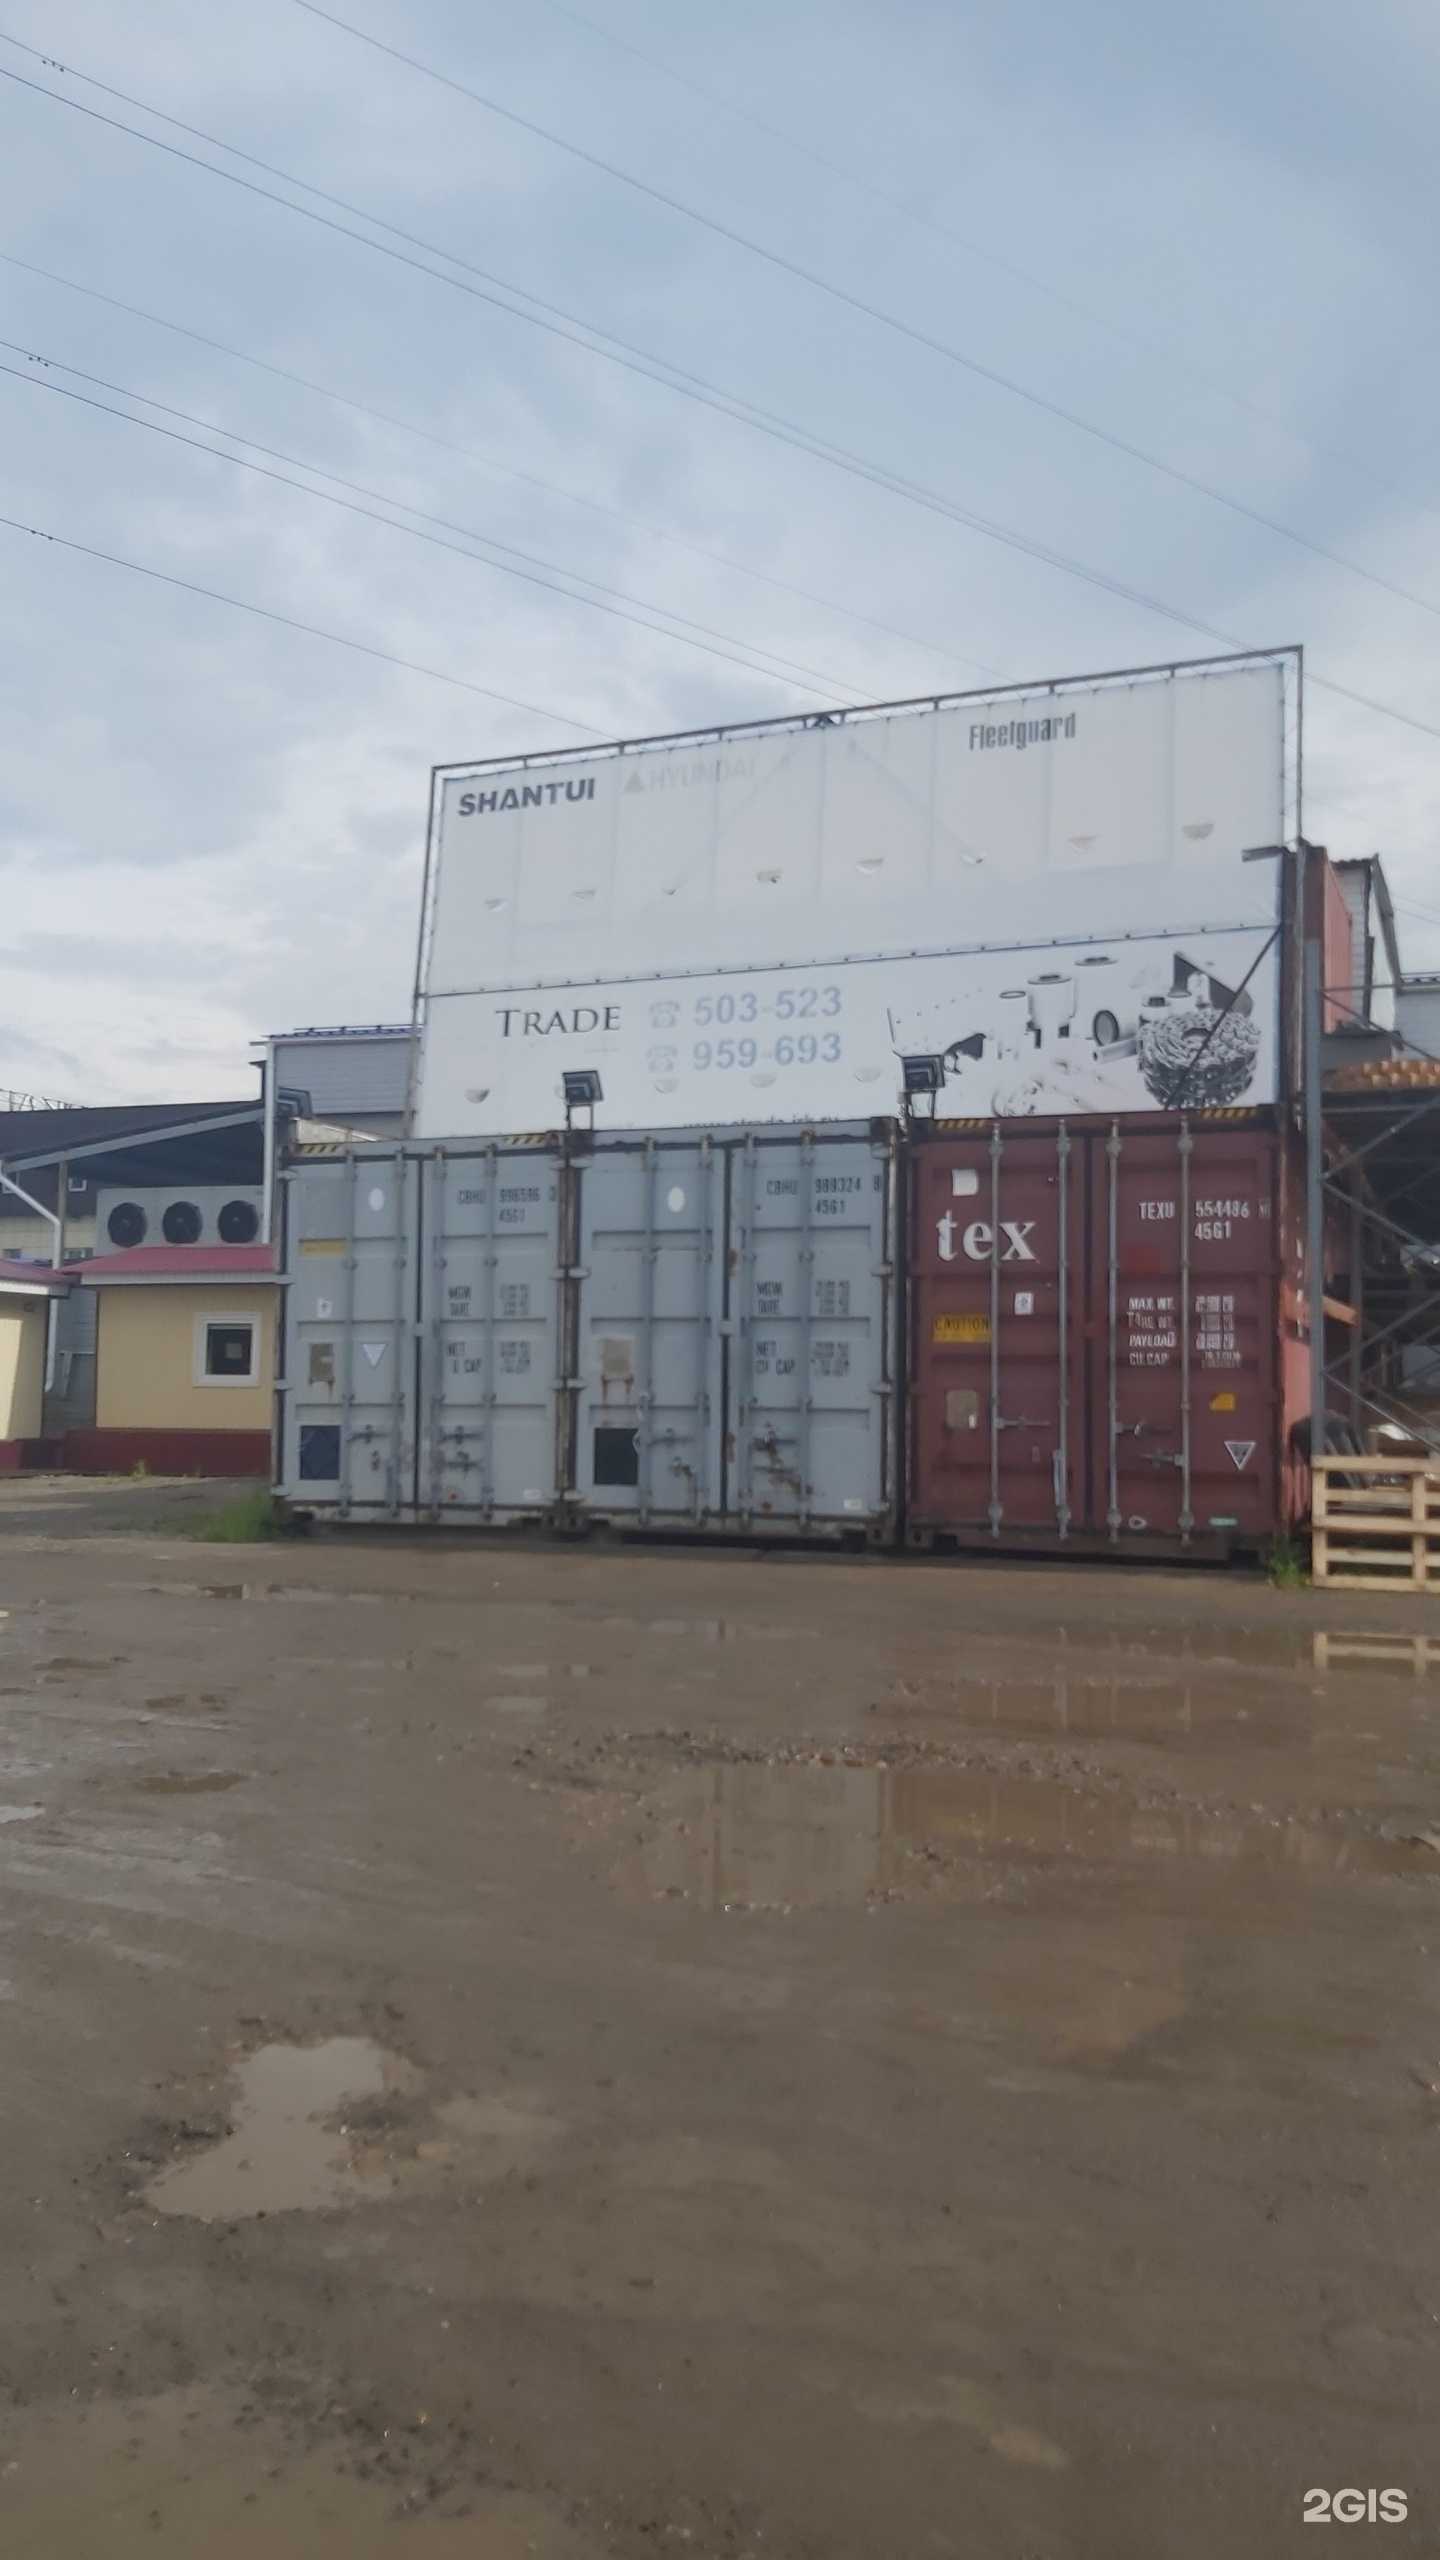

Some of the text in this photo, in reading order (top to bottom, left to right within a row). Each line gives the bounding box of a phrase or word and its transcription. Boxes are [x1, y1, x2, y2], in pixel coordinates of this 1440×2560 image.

[969, 712, 1076, 751] Fleetguard
[648, 759, 756, 791] HYUNDAI
[458, 777, 596, 817] SHANTUI
[495, 1006, 621, 1038] TRADE
[693, 985, 842, 1027] 503-523
[692, 1031, 842, 1071] 959-693
[1138, 1201, 1176, 1220] TEXU
[936, 1210, 1038, 1262] tex
[1129, 1331, 1177, 1348] PAYLOAD
